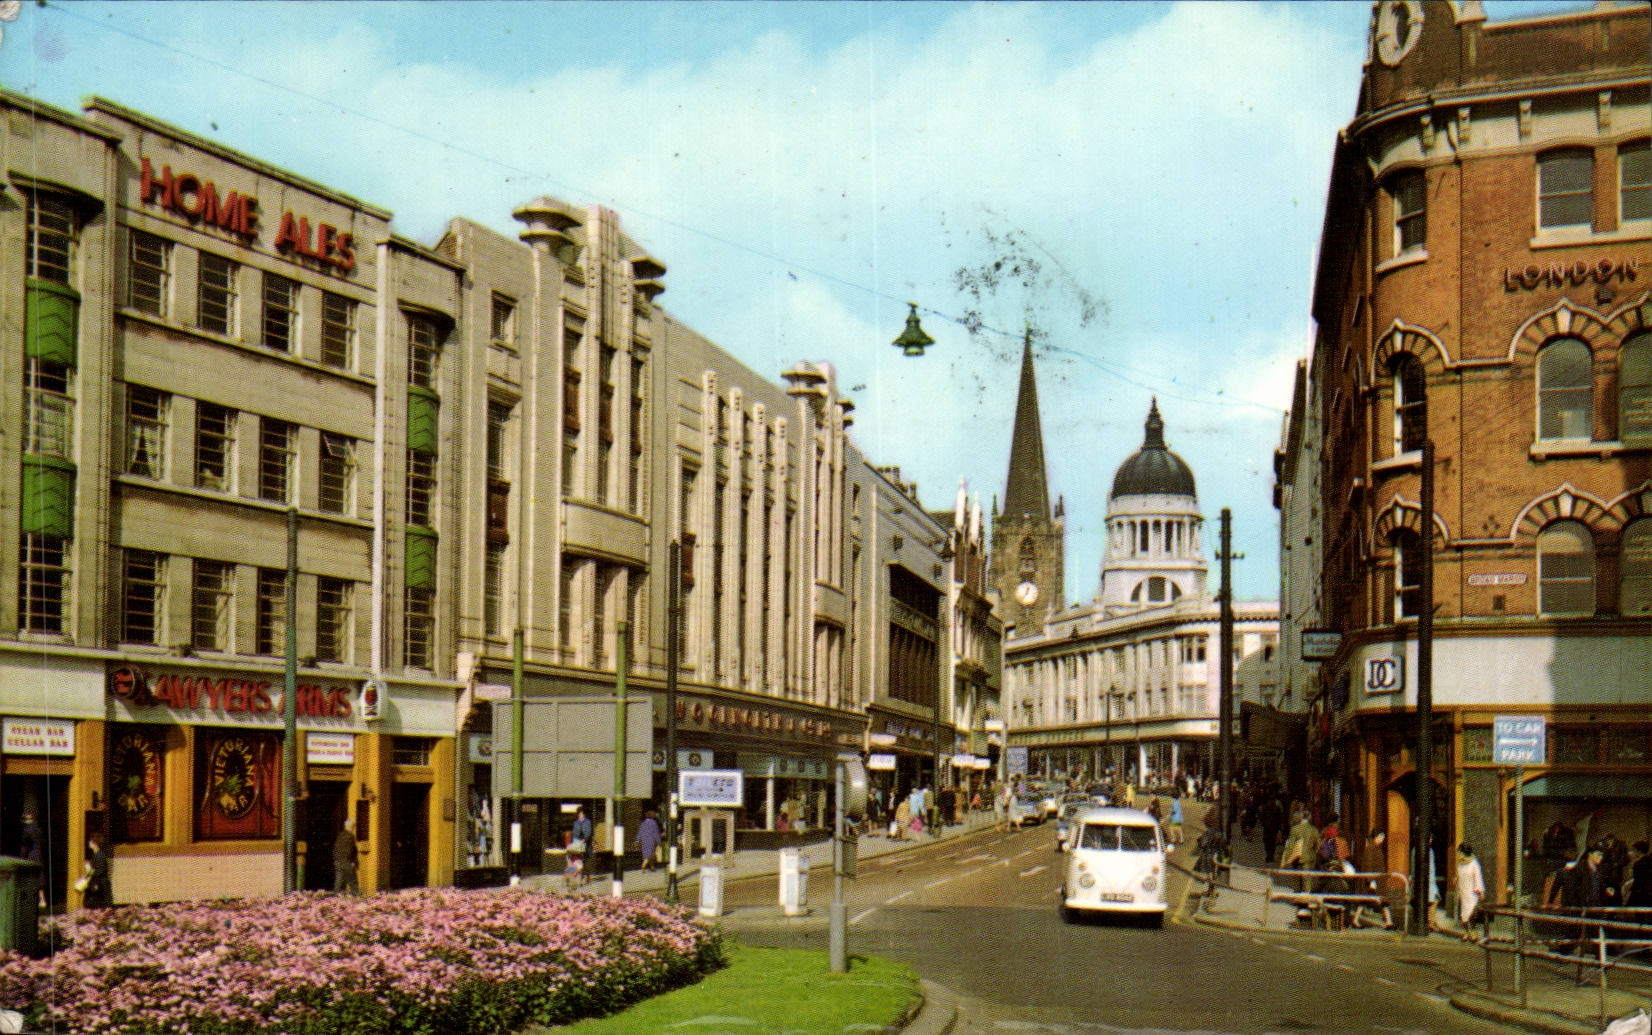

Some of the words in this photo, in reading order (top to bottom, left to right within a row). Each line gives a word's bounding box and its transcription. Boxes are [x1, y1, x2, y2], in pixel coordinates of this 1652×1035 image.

[140, 157, 259, 239] HOME
[274, 209, 355, 271] ALES
[1503, 257, 1639, 293] LONDON
[276, 684, 351, 718] RMS
[7, 736, 44, 747] CELLAR
[1497, 721, 1513, 734] TO
[1515, 721, 1542, 735] CAR
[214, 738, 255, 787] VICTORIANA
[1501, 748, 1534, 761] PARK
